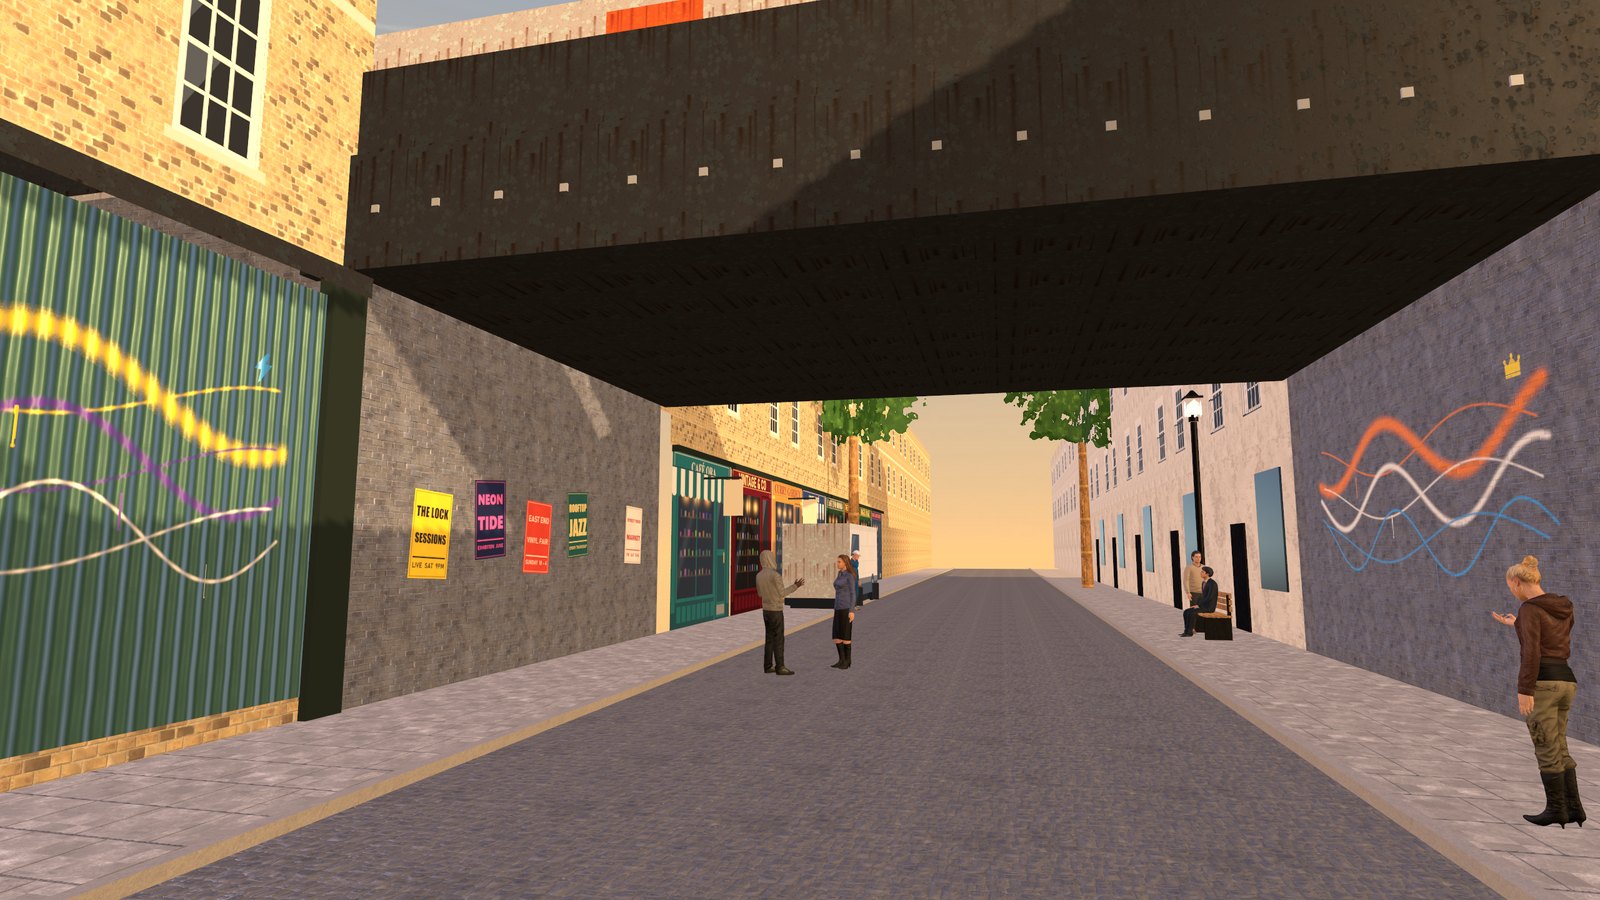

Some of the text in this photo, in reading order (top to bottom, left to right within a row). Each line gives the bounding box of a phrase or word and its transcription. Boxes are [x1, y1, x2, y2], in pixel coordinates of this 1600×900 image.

[478, 494, 503, 506] NEON
[417, 505, 449, 520] THE LOCK
[528, 514, 540, 523] EAST
[478, 515, 504, 531] TIDE
[569, 517, 587, 537] JAZZ
[414, 532, 447, 545] SESSIONS
